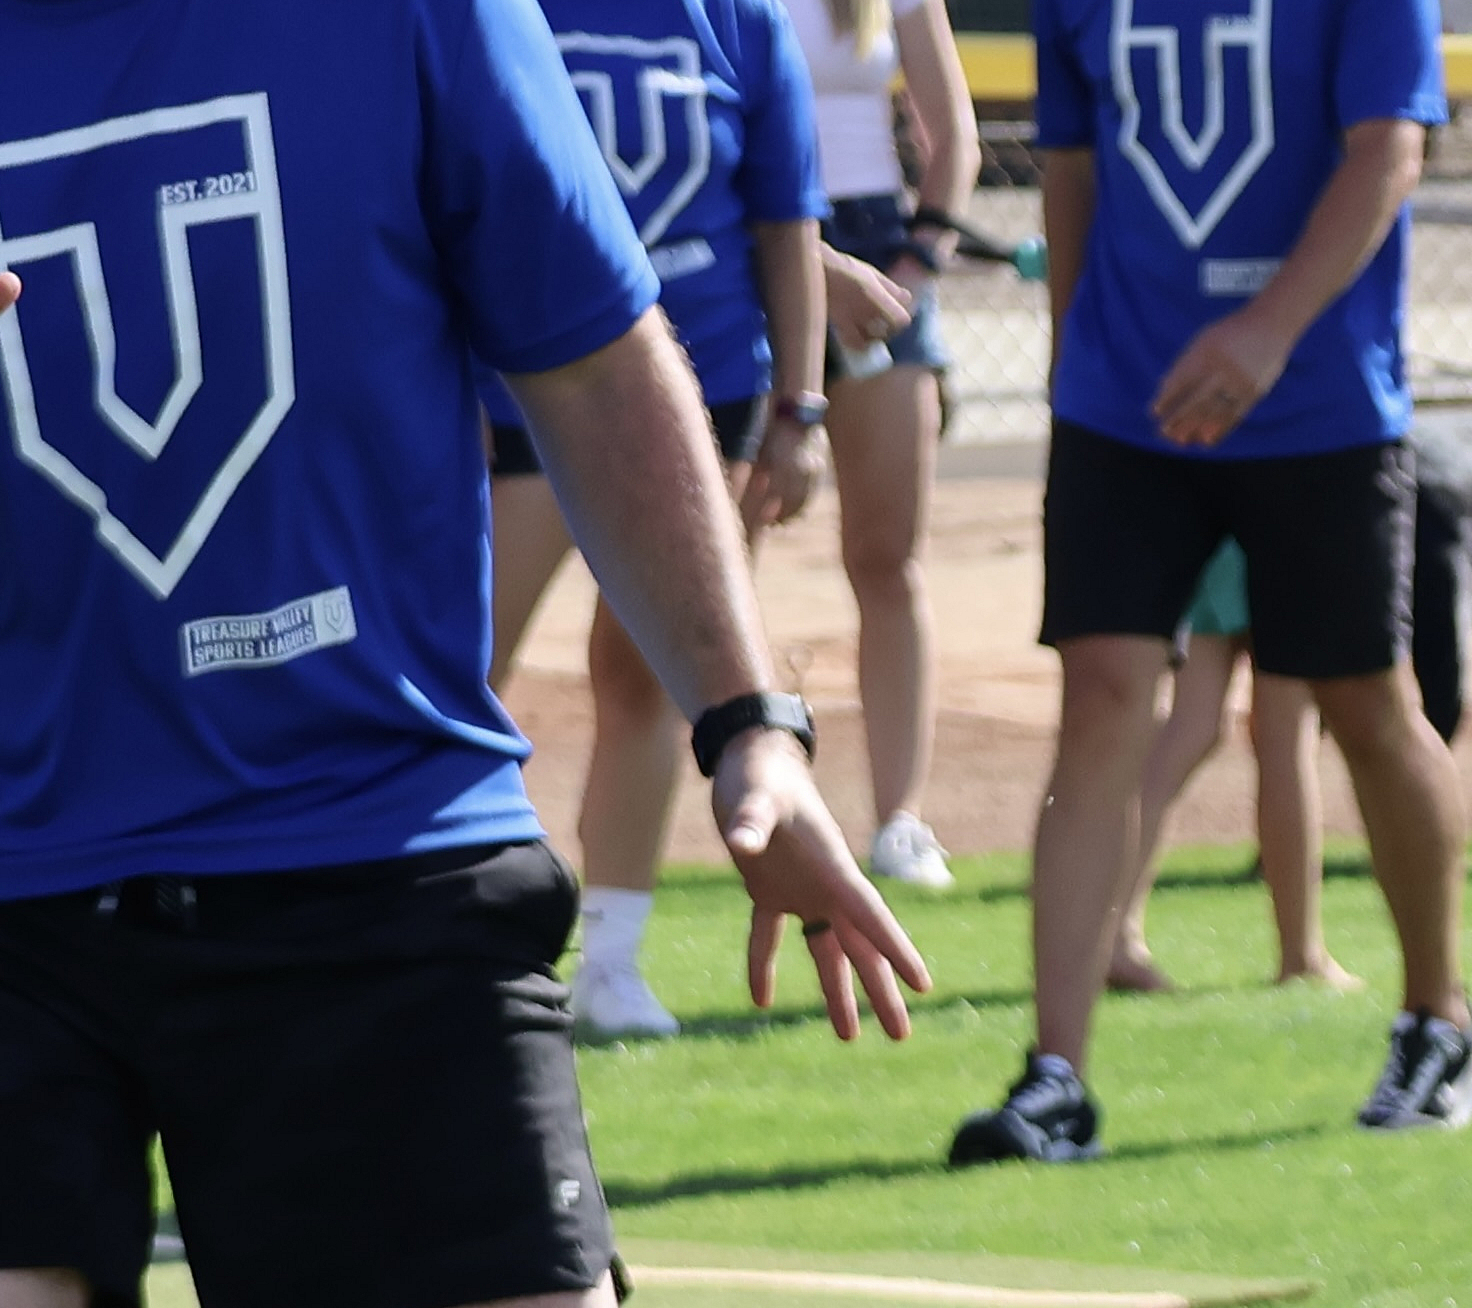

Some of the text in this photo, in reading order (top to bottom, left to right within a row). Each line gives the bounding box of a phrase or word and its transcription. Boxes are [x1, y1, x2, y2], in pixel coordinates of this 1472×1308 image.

[161, 171, 256, 205] EST. 2021
[193, 618, 270, 644] TREASURE
[194, 641, 255, 666] SPORTS
